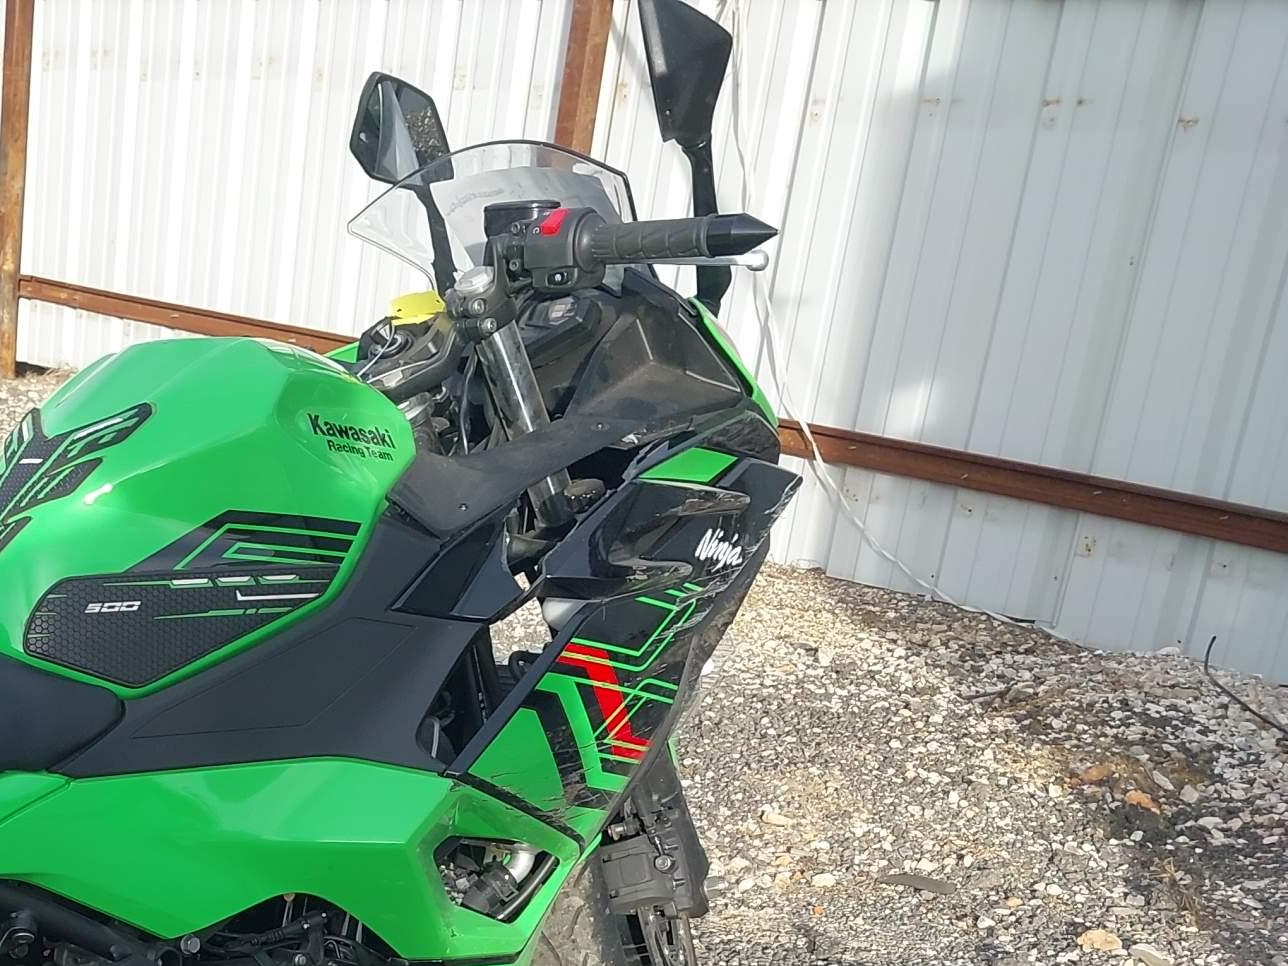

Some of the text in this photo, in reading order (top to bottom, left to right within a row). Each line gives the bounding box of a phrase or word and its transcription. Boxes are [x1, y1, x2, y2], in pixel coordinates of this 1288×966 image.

[307, 413, 396, 449] Kawasaki
[326, 439, 394, 461] Racing Team
[694, 527, 743, 573] Ninja
[84, 600, 142, 614] 500
